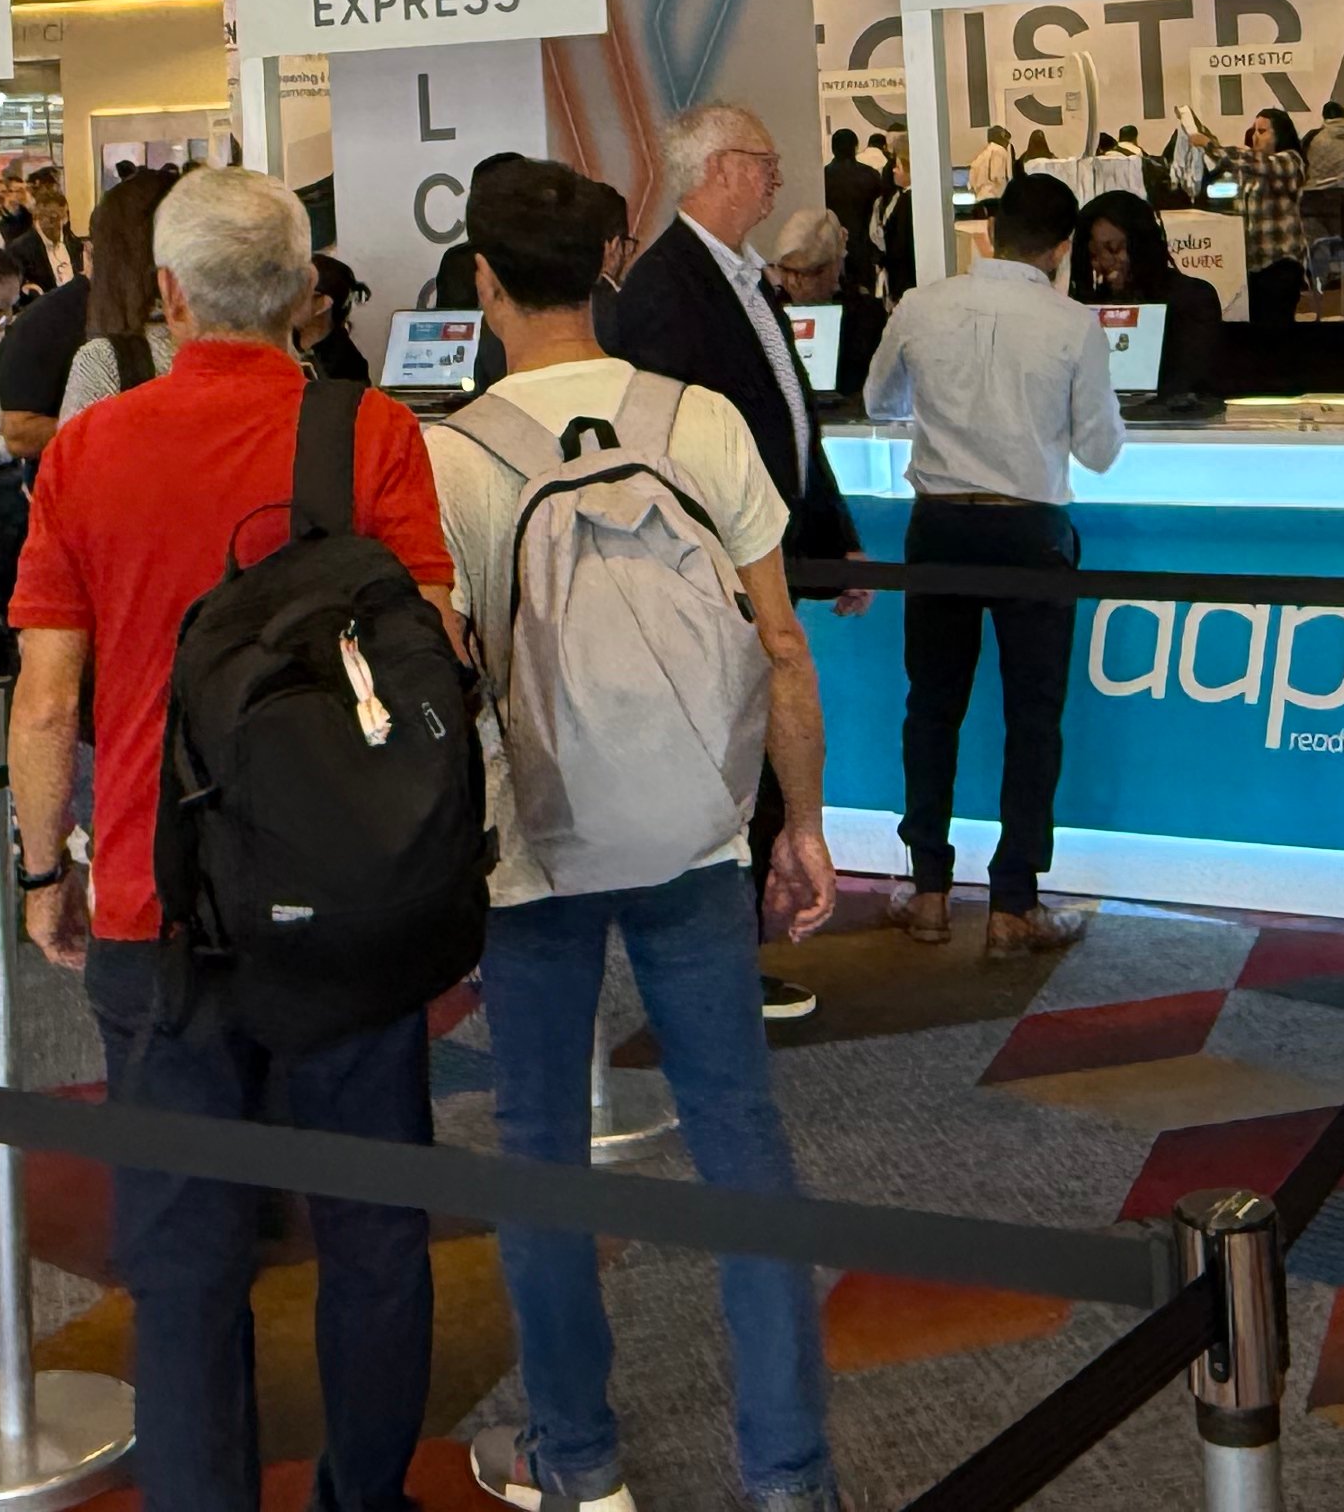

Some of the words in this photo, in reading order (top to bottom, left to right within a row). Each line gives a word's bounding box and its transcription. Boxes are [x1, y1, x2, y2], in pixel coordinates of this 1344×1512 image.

[1208, 51, 1294, 68] DOMESTIC
[1012, 66, 1065, 82] DOMES
[821, 77, 906, 92] INTERNATIONA
